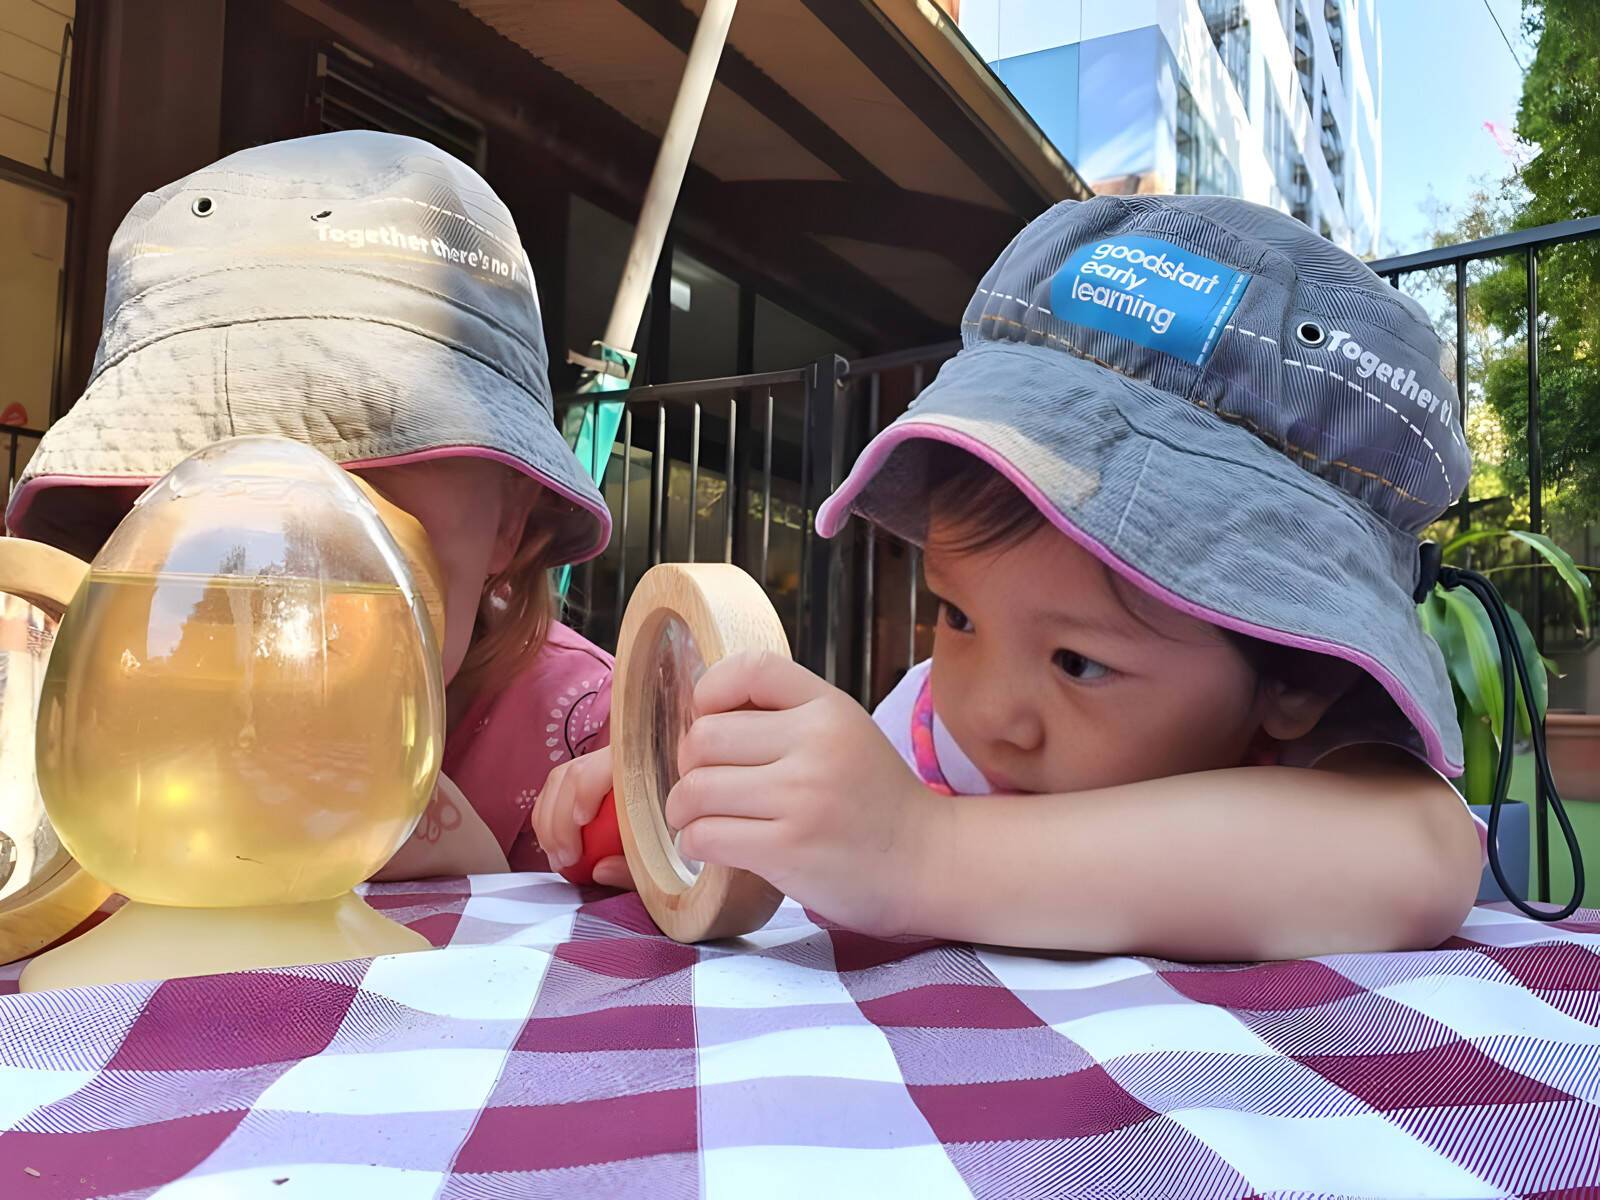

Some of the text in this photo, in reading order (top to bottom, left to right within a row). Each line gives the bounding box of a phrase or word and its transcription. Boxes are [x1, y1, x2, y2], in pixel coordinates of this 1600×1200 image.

[316, 225, 429, 253] Together
[431, 237, 489, 270] there's
[491, 259, 509, 276] no
[1080, 261, 1146, 291] early
[1092, 243, 1219, 294] goodstart
[1072, 275, 1176, 334] learning
[1327, 330, 1440, 414] Together
